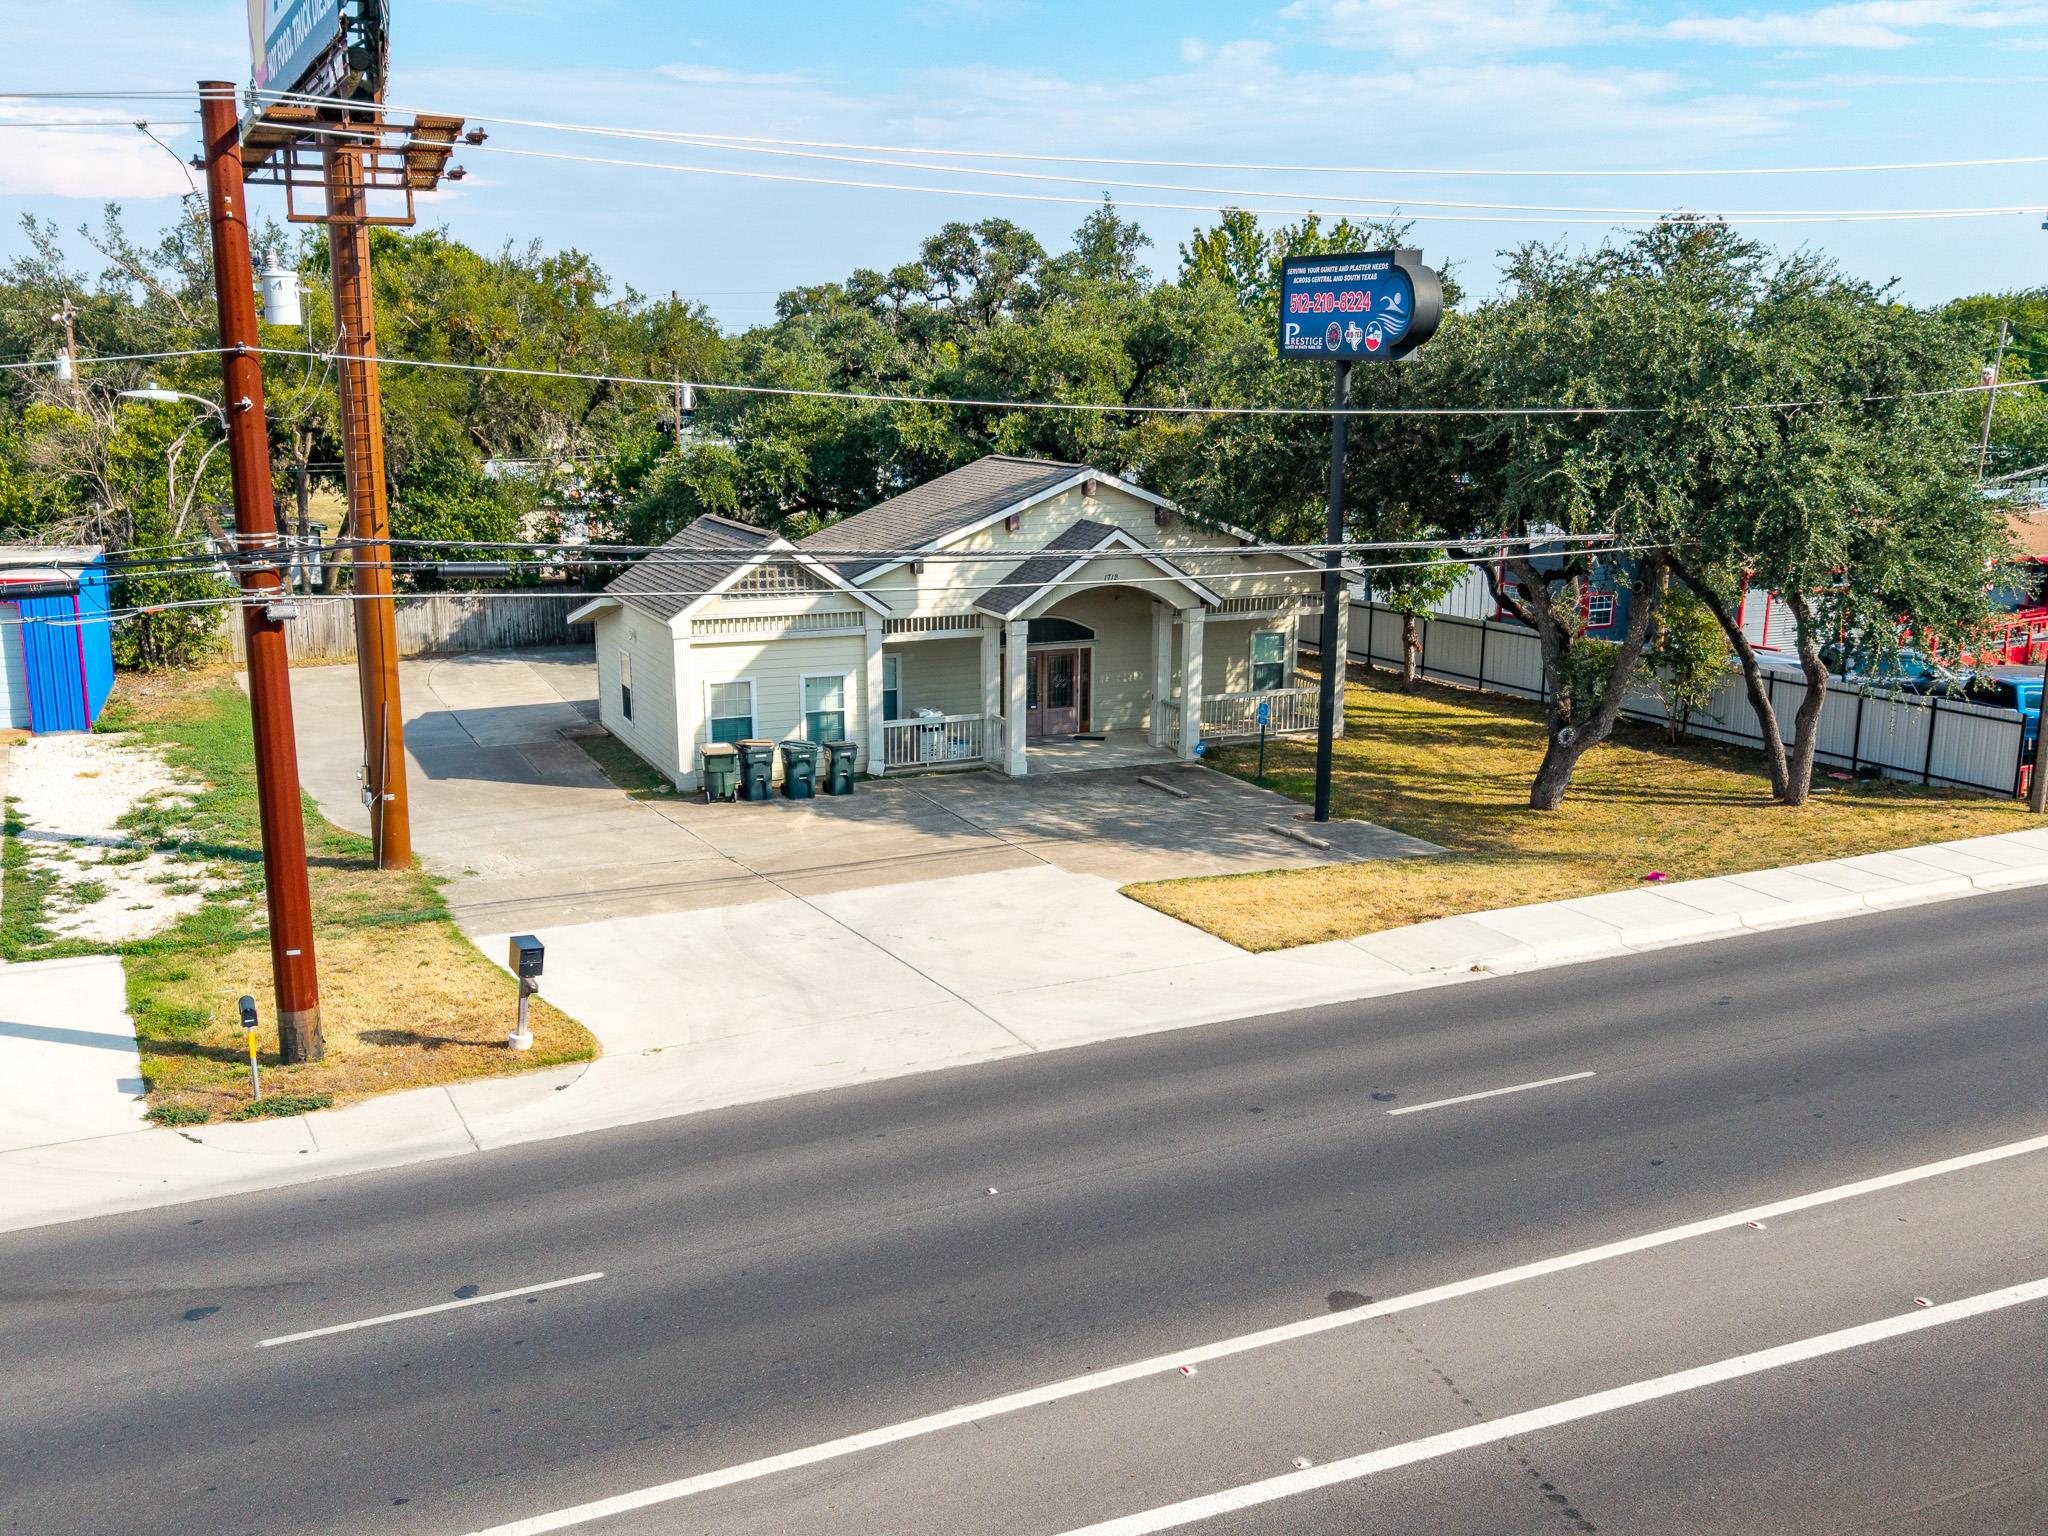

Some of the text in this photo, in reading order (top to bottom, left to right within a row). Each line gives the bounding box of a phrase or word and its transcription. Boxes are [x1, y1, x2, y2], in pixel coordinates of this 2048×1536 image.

[267, 43, 278, 82] HOT
[292, 0, 312, 51] TRUCK
[1287, 267, 1306, 275] SERVING
[1343, 274, 1361, 282] SOUTH
[1361, 273, 1378, 281] TEXAS
[1290, 290, 1371, 313] 512-210-8224
[1104, 573, 1119, 581] 1712
